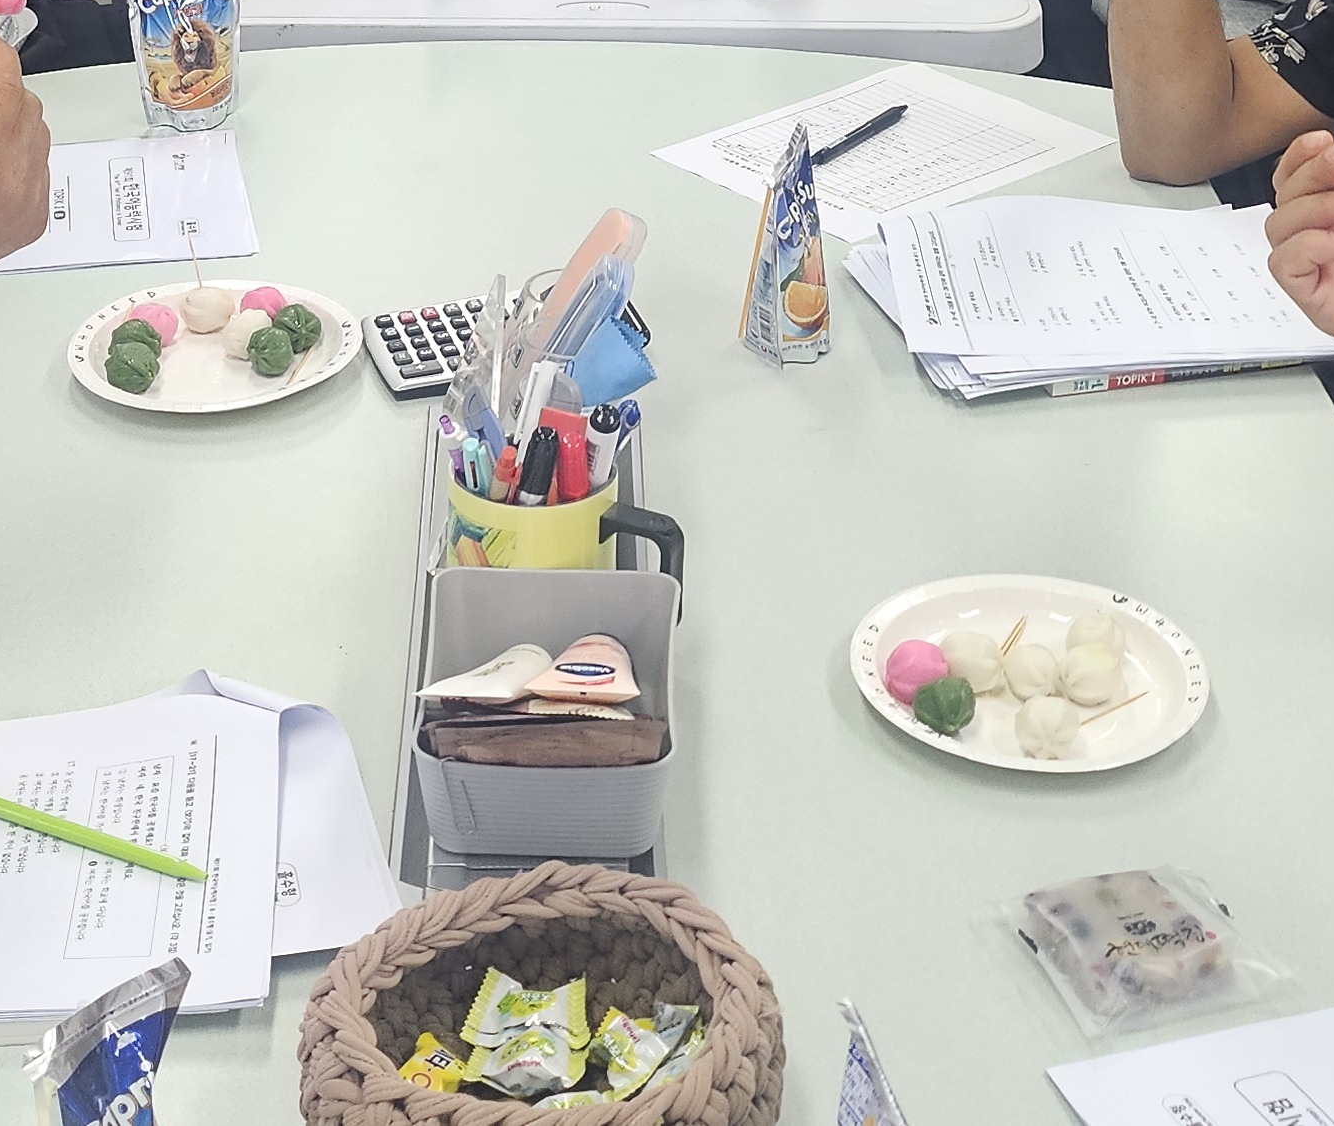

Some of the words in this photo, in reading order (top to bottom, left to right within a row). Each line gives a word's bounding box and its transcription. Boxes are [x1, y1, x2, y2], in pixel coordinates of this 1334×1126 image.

[53, 189, 65, 205] TOPIK
[123, 183, 143, 231] 한국어능력시험
[1116, 372, 1147, 386] TOPIK
[277, 871, 297, 897] 홀수형
